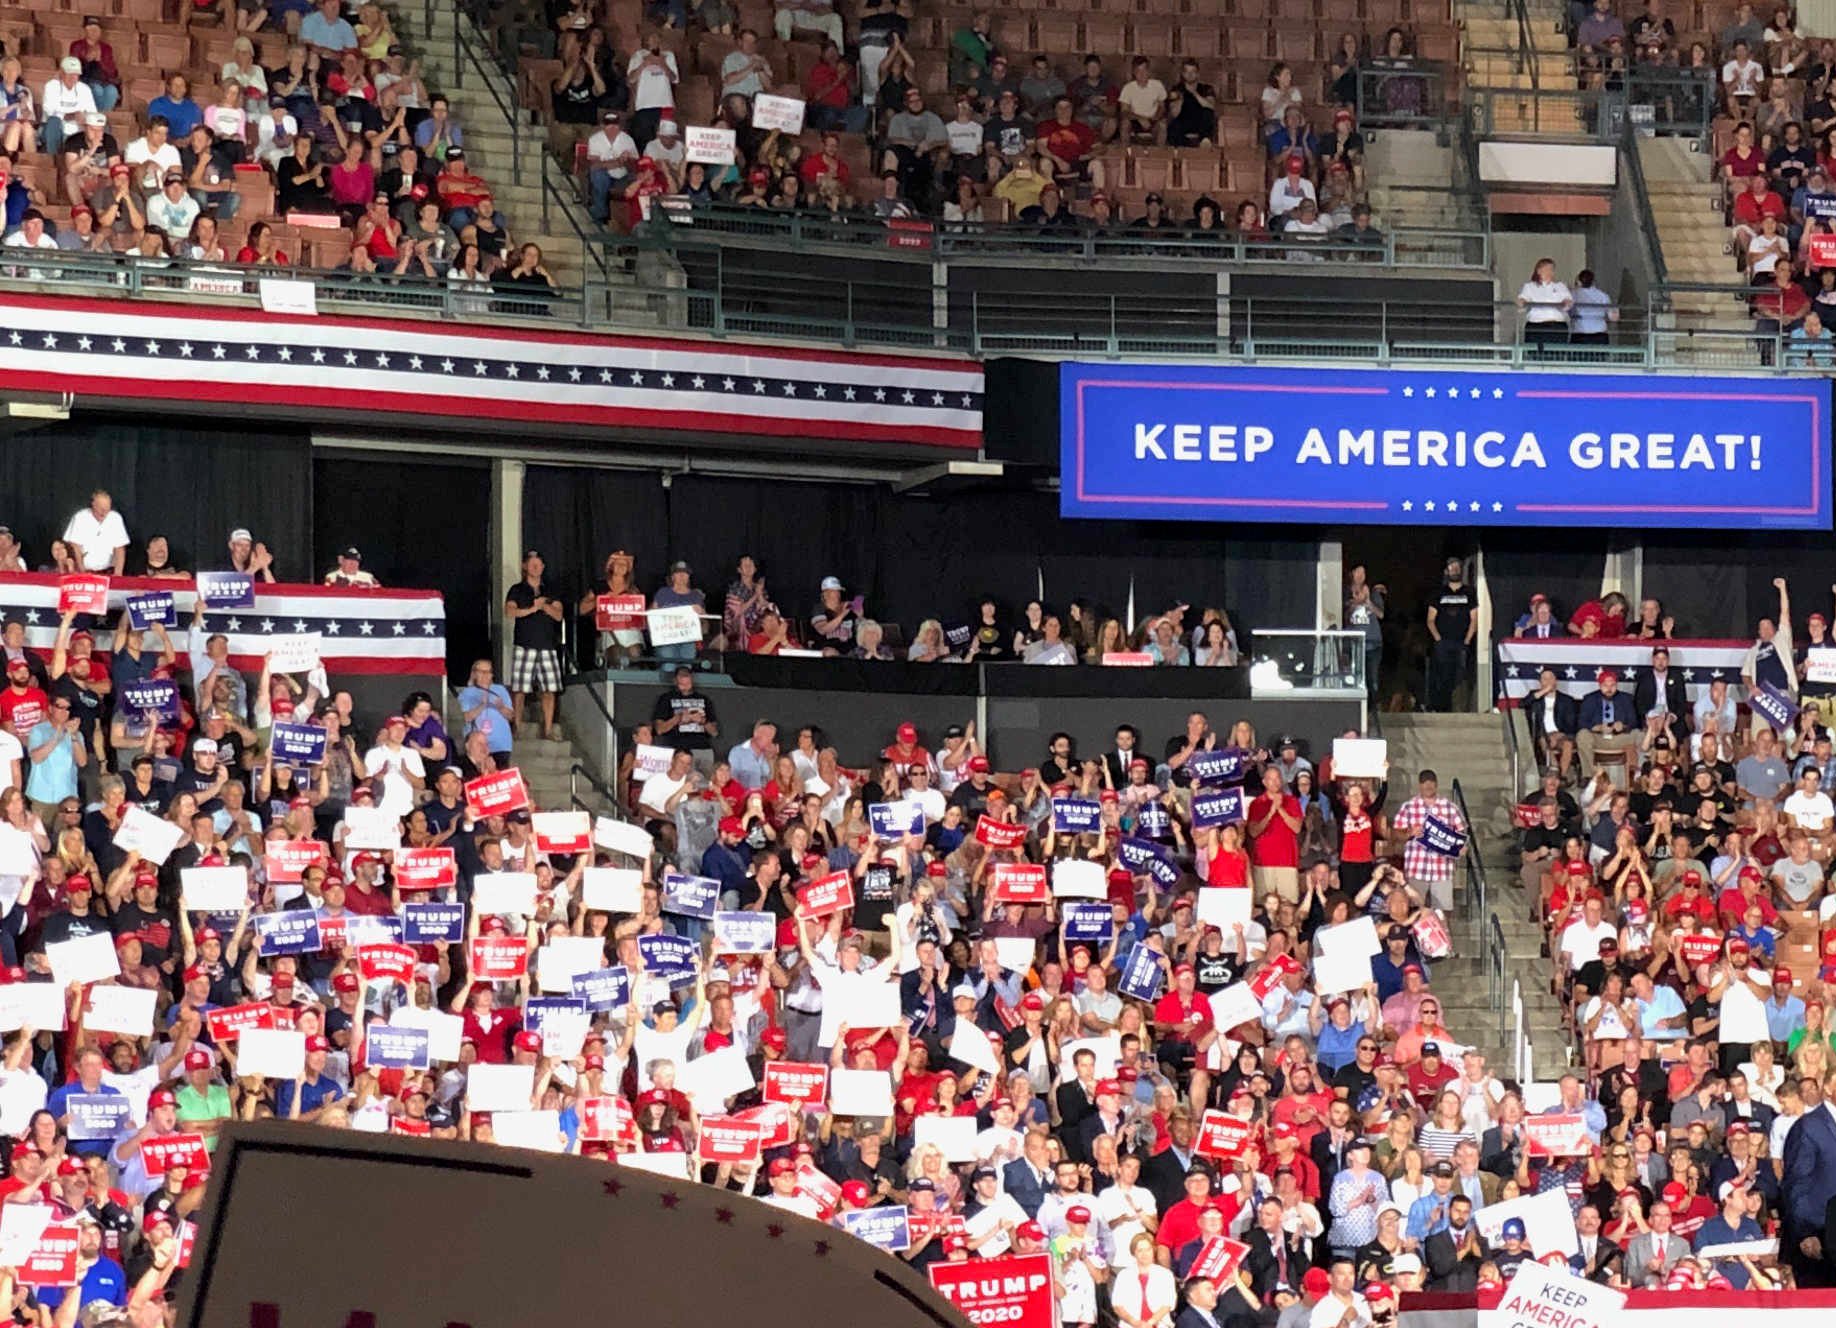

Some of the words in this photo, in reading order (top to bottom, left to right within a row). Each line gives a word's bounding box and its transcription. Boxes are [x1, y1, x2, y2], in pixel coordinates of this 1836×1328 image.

[1133, 423, 1274, 463] KEEP
[1295, 427, 1548, 469] AMERICA
[1568, 430, 1764, 472] GREAT!
[130, 599, 173, 610] TRUMP
[125, 688, 174, 699] TRUMP
[275, 729, 325, 743] TRUMP
[1195, 757, 1238, 770] TRUMP
[470, 775, 519, 798] TRUMP
[1054, 804, 1100, 814] TRUMP
[1195, 797, 1238, 811] TRUMP
[1425, 821, 1465, 845] TRUMP
[407, 912, 461, 921] TRUMP
[1067, 911, 1112, 921] TRUMP
[475, 946, 526, 957] TRUMP
[641, 941, 692, 954] TRUMP
[361, 951, 413, 965] TRUMP
[212, 1007, 269, 1023] TRUMP
[769, 1071, 823, 1083] TRUMP
[938, 1274, 1047, 1300] TRUMP
[1540, 1283, 1587, 1308] KEEP
[967, 1305, 1024, 1324] 2020
